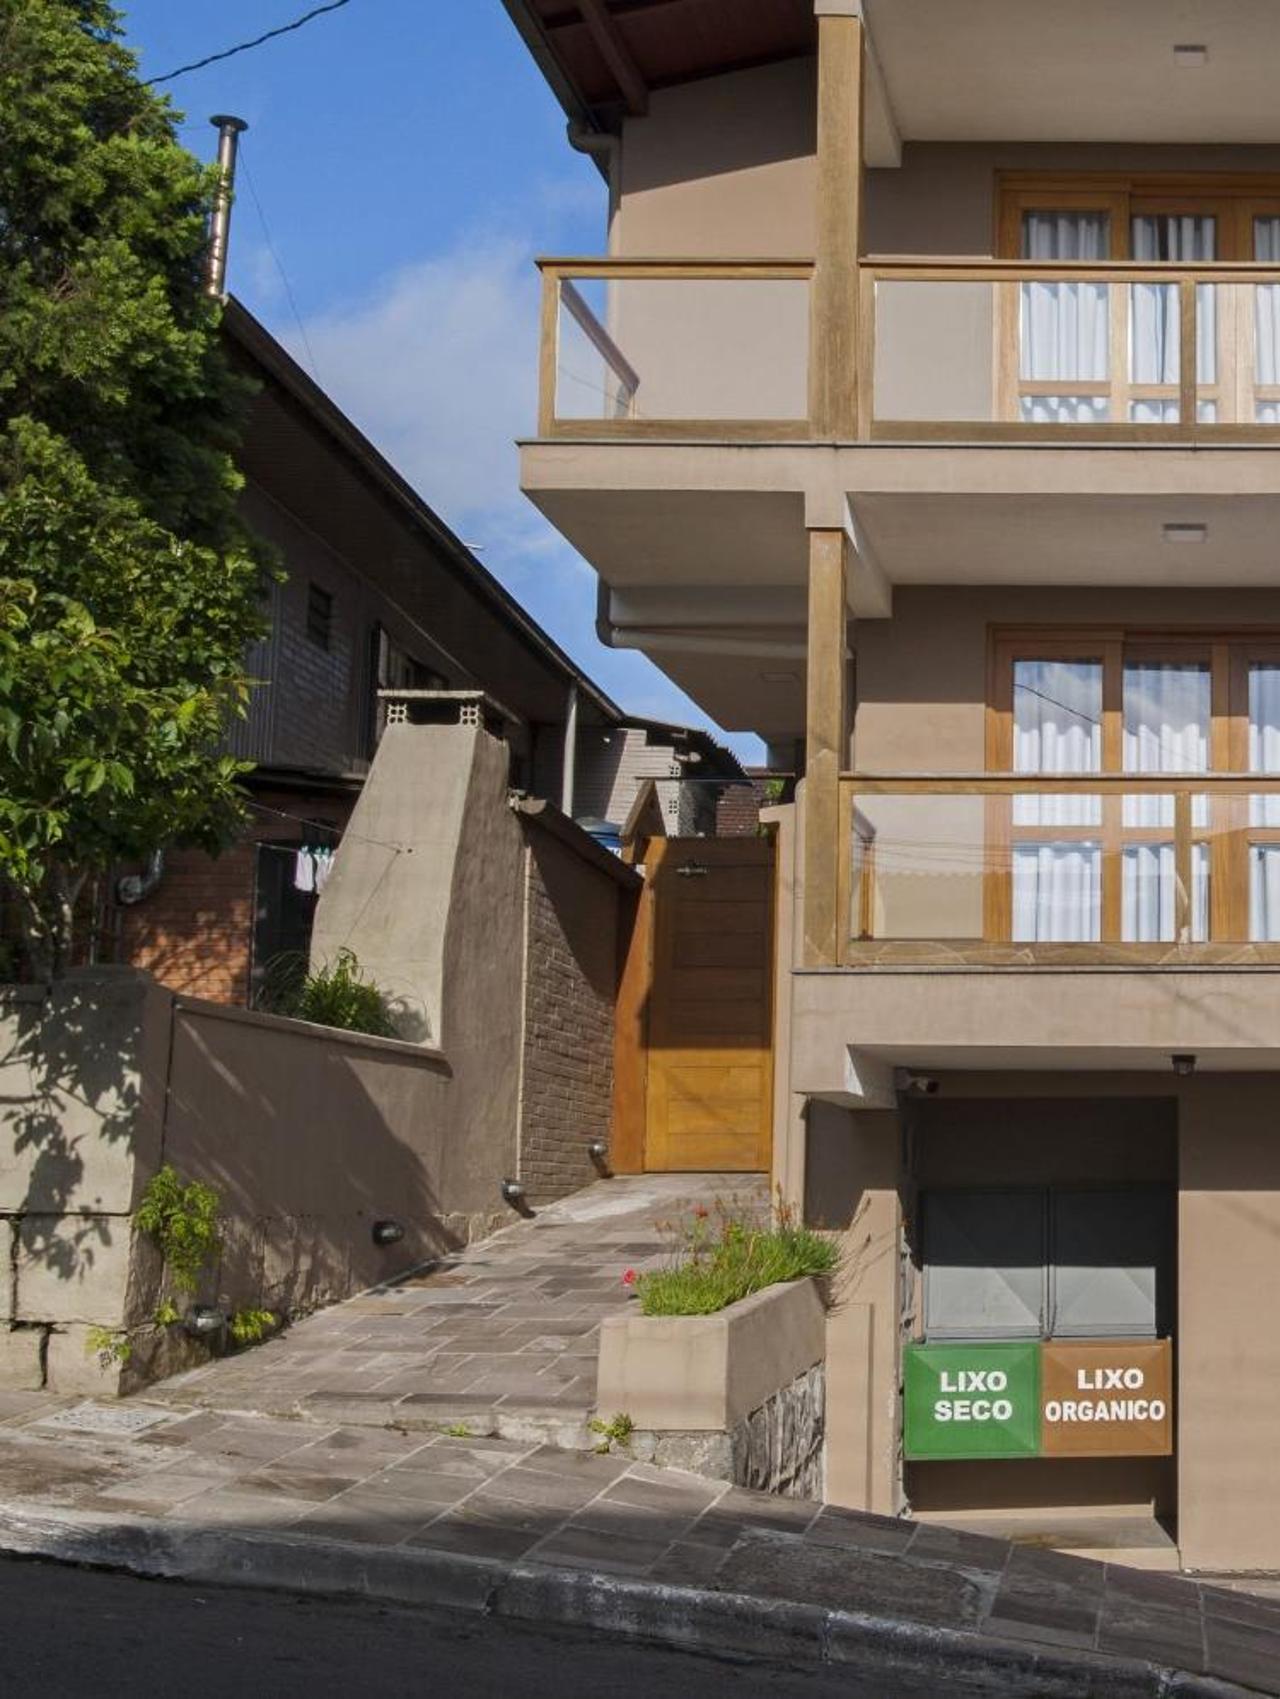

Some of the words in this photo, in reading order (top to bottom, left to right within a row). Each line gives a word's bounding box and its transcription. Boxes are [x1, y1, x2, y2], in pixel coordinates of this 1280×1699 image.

[940, 1370, 1008, 1393] LIXO
[1077, 1368, 1144, 1390] LIXO
[934, 1399, 1013, 1422] SECO
[1045, 1399, 1165, 1422] ORGANICO
